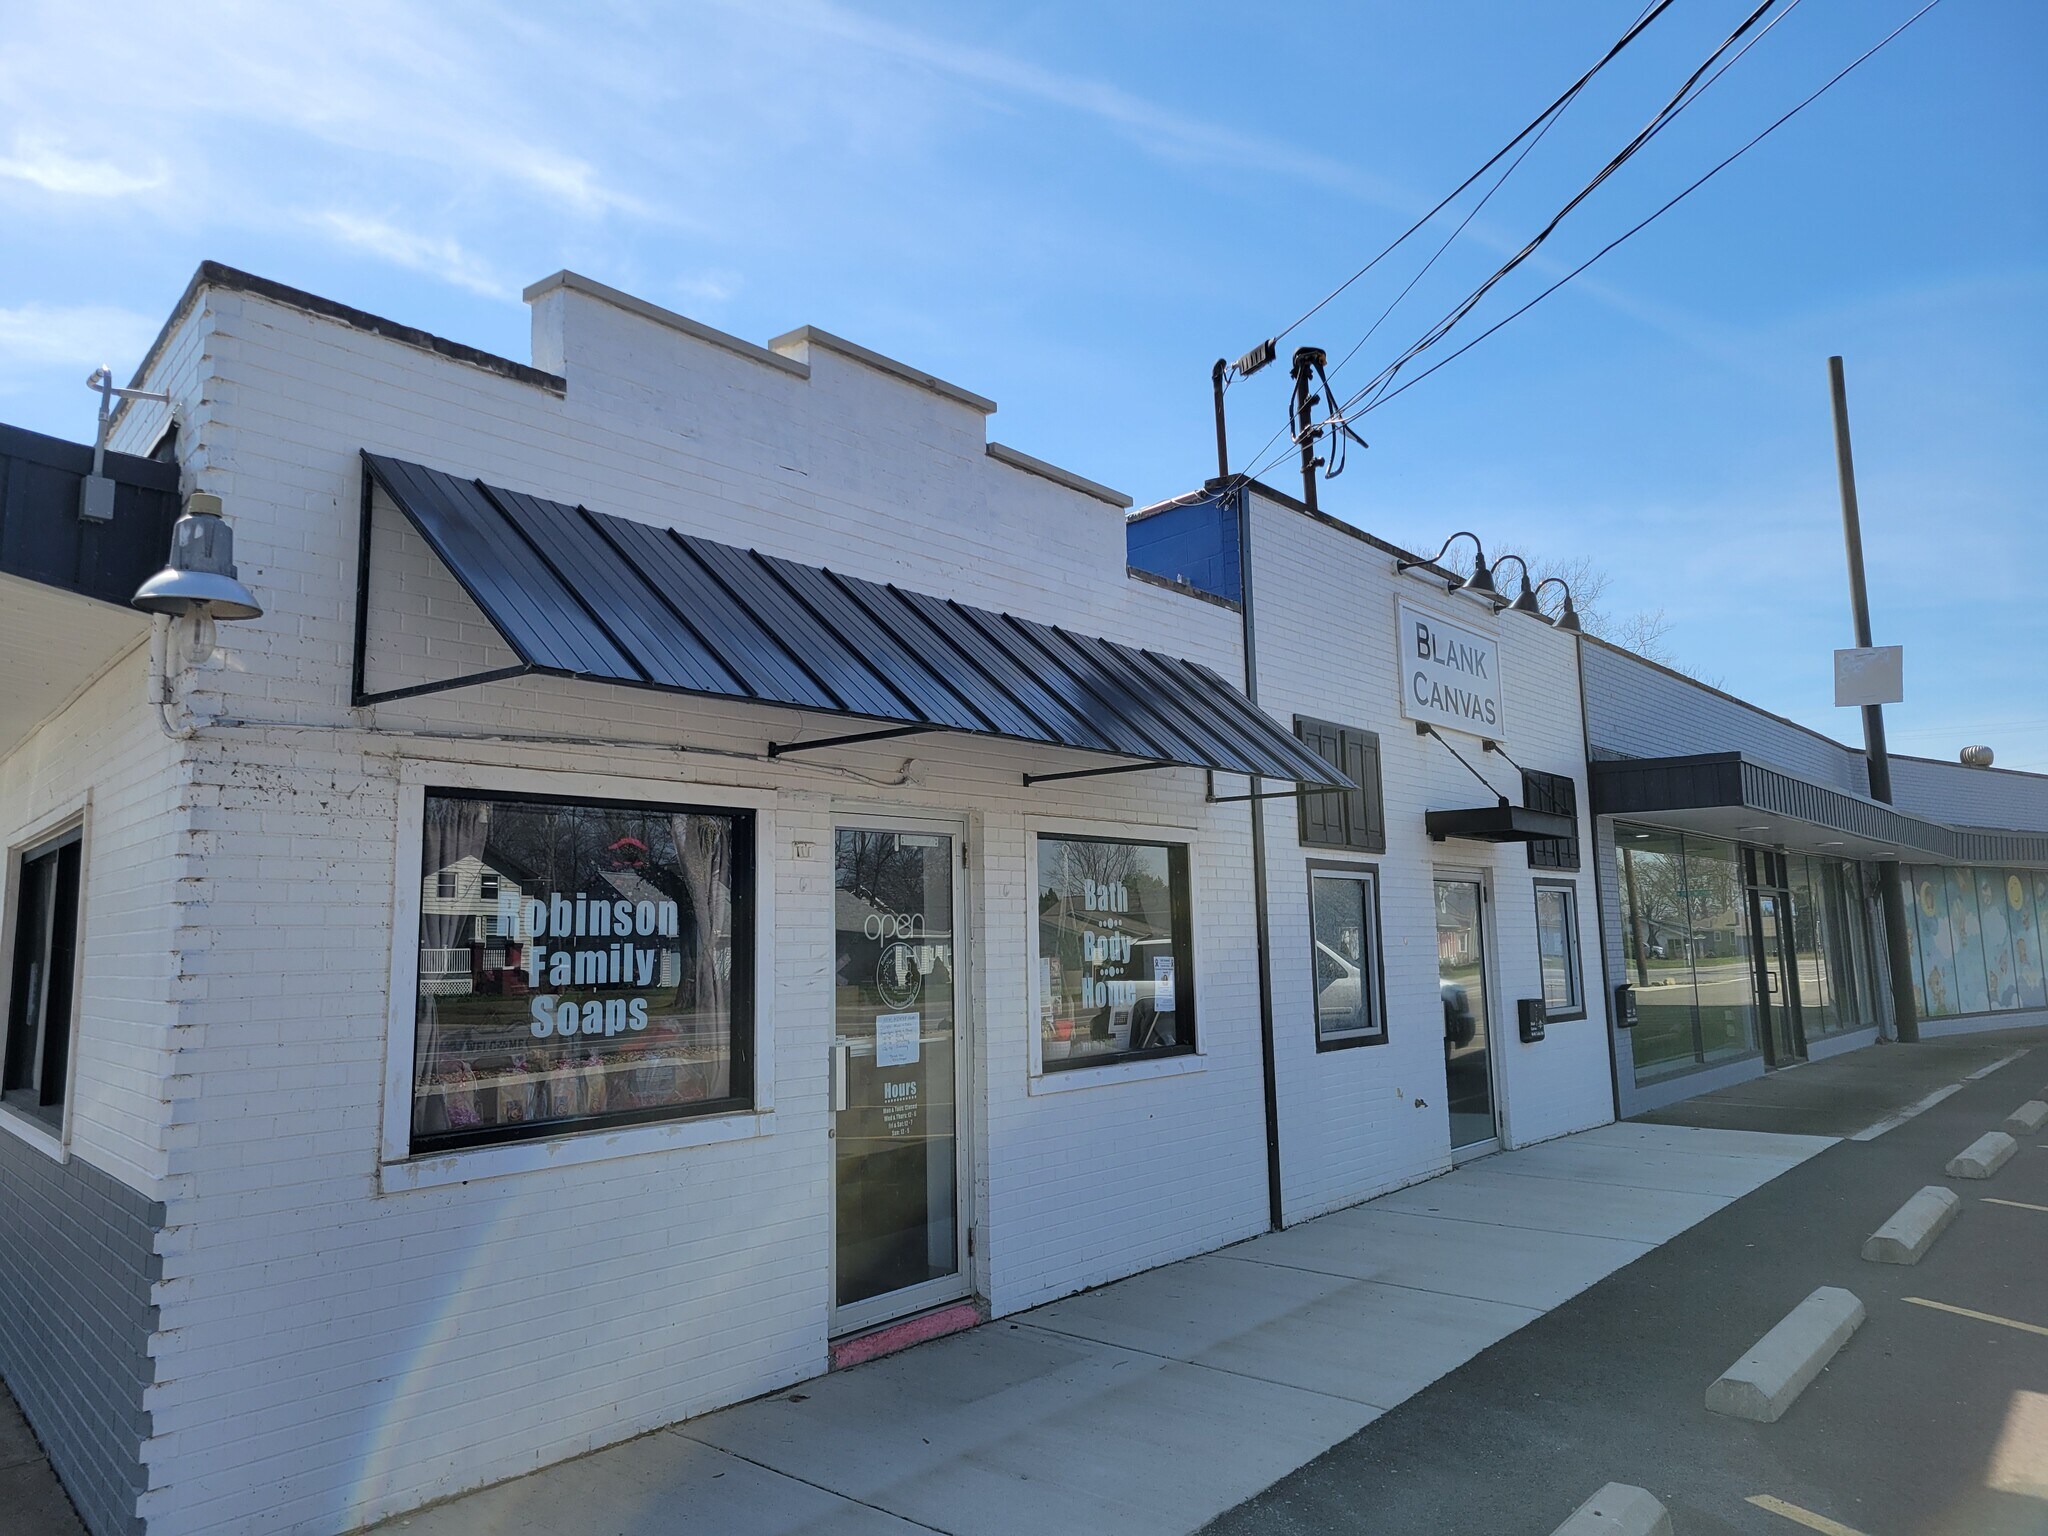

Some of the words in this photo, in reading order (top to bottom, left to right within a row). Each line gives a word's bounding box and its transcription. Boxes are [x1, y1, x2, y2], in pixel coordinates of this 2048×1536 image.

[1415, 622, 1488, 680] BLANK
[1413, 671, 1496, 725] CANVAS
[1084, 878, 1128, 913] Bath
[496, 892, 679, 939] Robinson
[864, 913, 925, 948] open
[528, 943, 655, 988] Family
[1083, 930, 1132, 964] Body
[1081, 976, 1137, 1009] Home
[530, 995, 648, 1038] Soaps
[884, 1081, 917, 1099] Hours
